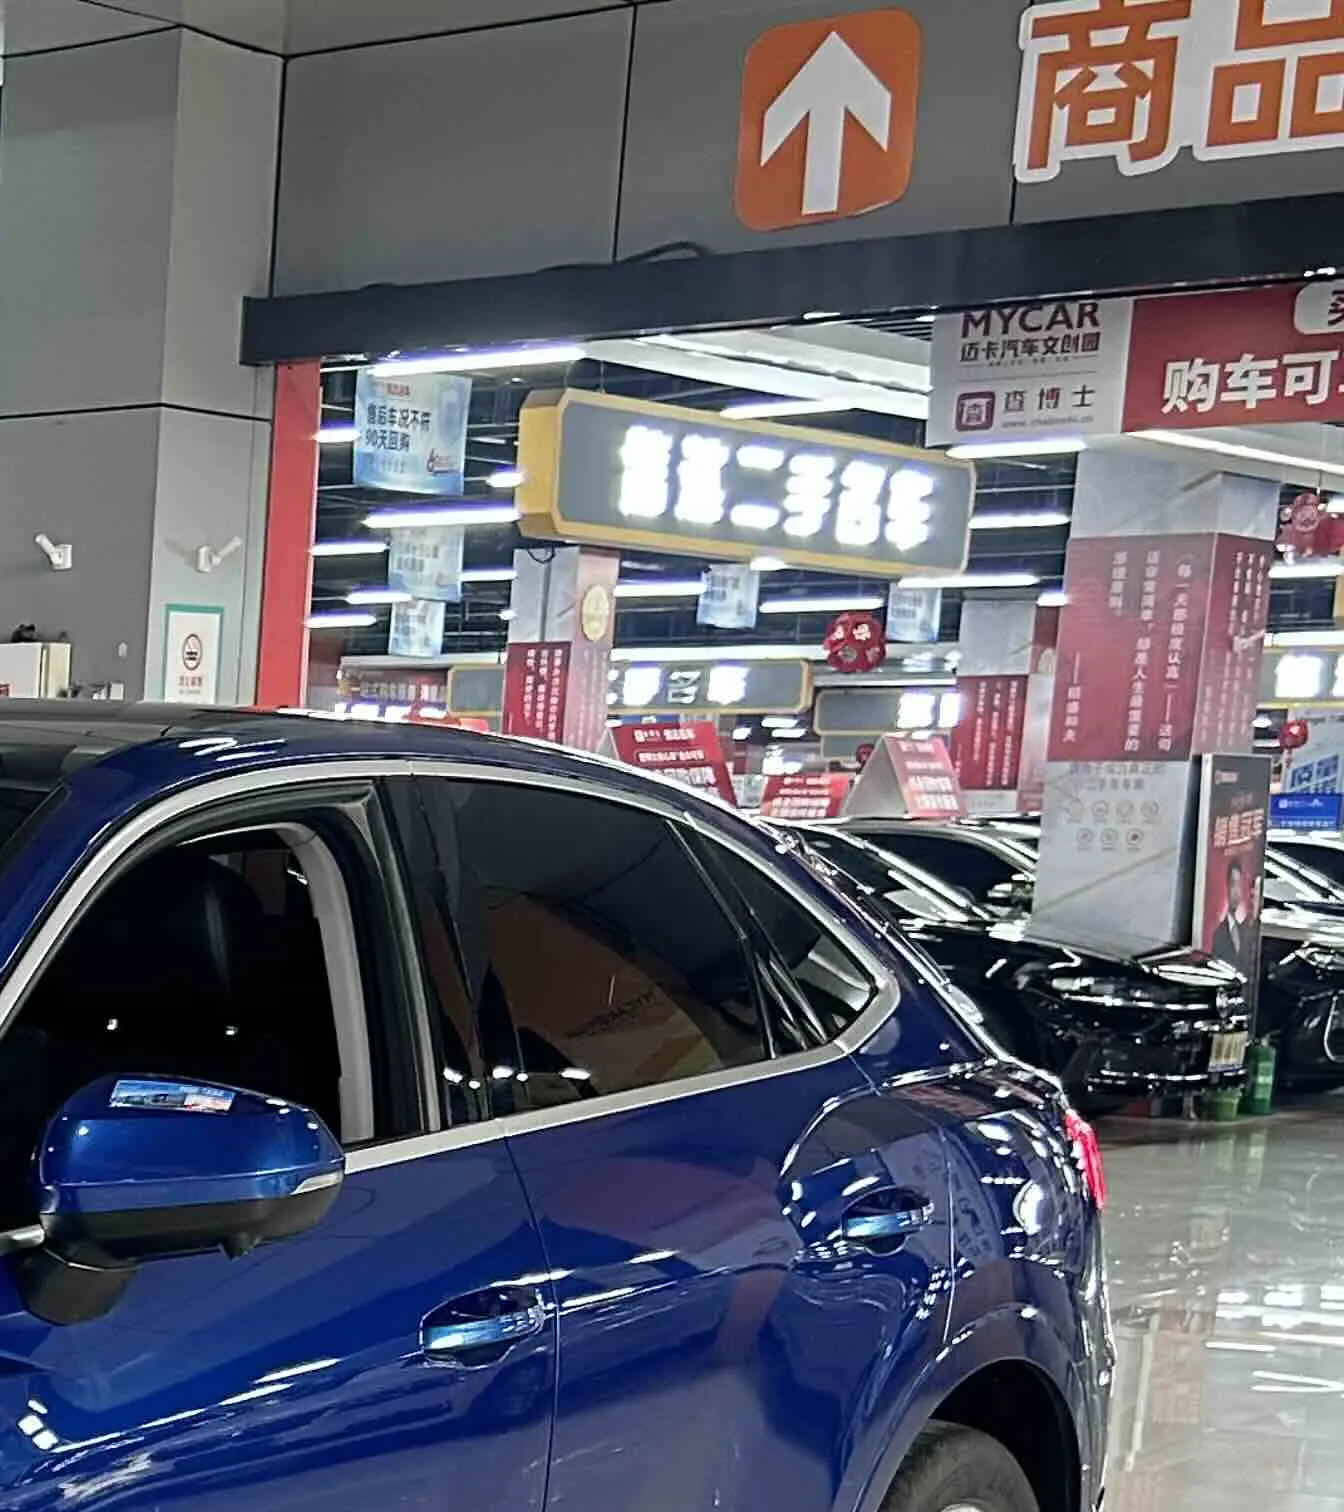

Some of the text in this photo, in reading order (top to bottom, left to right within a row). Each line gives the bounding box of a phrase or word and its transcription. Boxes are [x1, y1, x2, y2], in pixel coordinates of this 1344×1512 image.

[961, 302, 1099, 338] MYCAR
[1161, 349, 1344, 414] 购车可
